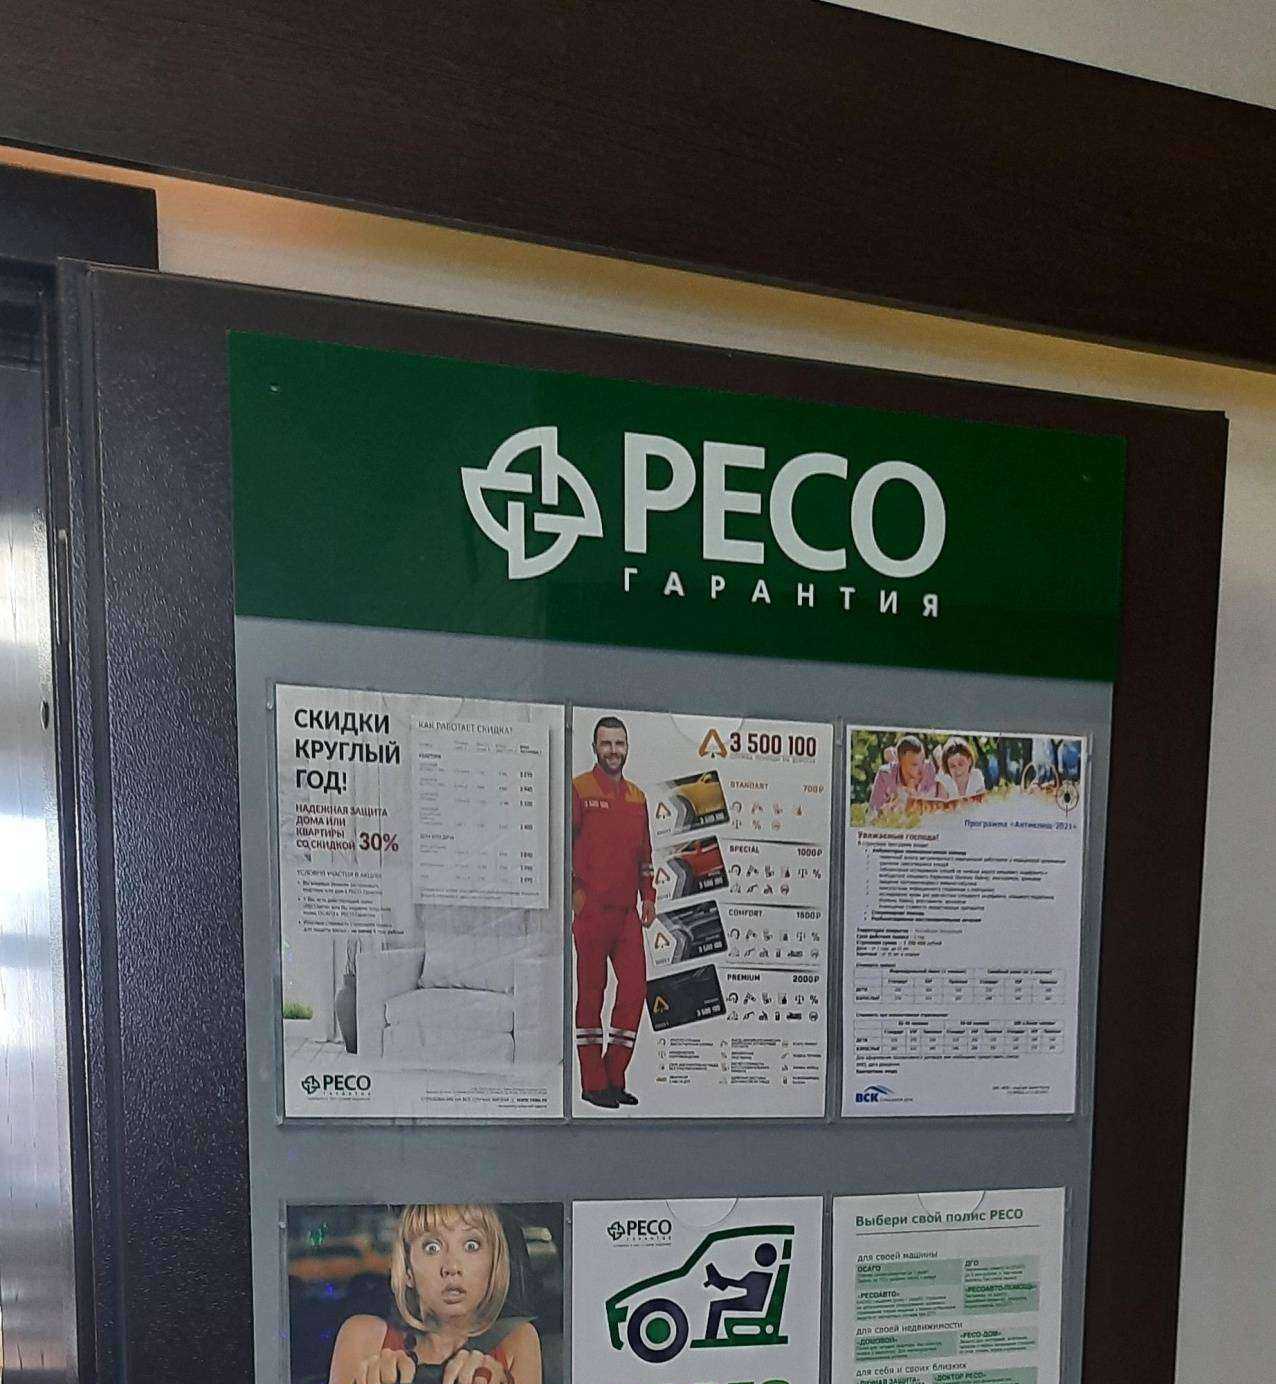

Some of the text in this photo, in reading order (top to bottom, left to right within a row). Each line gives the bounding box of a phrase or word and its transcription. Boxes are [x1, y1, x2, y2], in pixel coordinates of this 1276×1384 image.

[623, 430, 947, 579] РЕСО
[624, 567, 941, 618] ГАРАНТИЯ
[294, 708, 390, 735] СКИДКИ
[295, 739, 400, 765] КРУГЛЫЙ
[730, 732, 817, 757] 3 500 100
[296, 769, 347, 794] ГОД!
[296, 815, 346, 827] ДОМА ИЛИ
[296, 827, 345, 839] КВАРТИРЫ
[359, 831, 399, 852] 30%
[727, 973, 760, 982] PREMIUM
[323, 1074, 371, 1091] РЕСО
[855, 1093, 879, 1103] ВСК
[627, 1219, 672, 1236] РЕСО
[855, 1208, 1024, 1228] Выбери свой полис РЕСО
